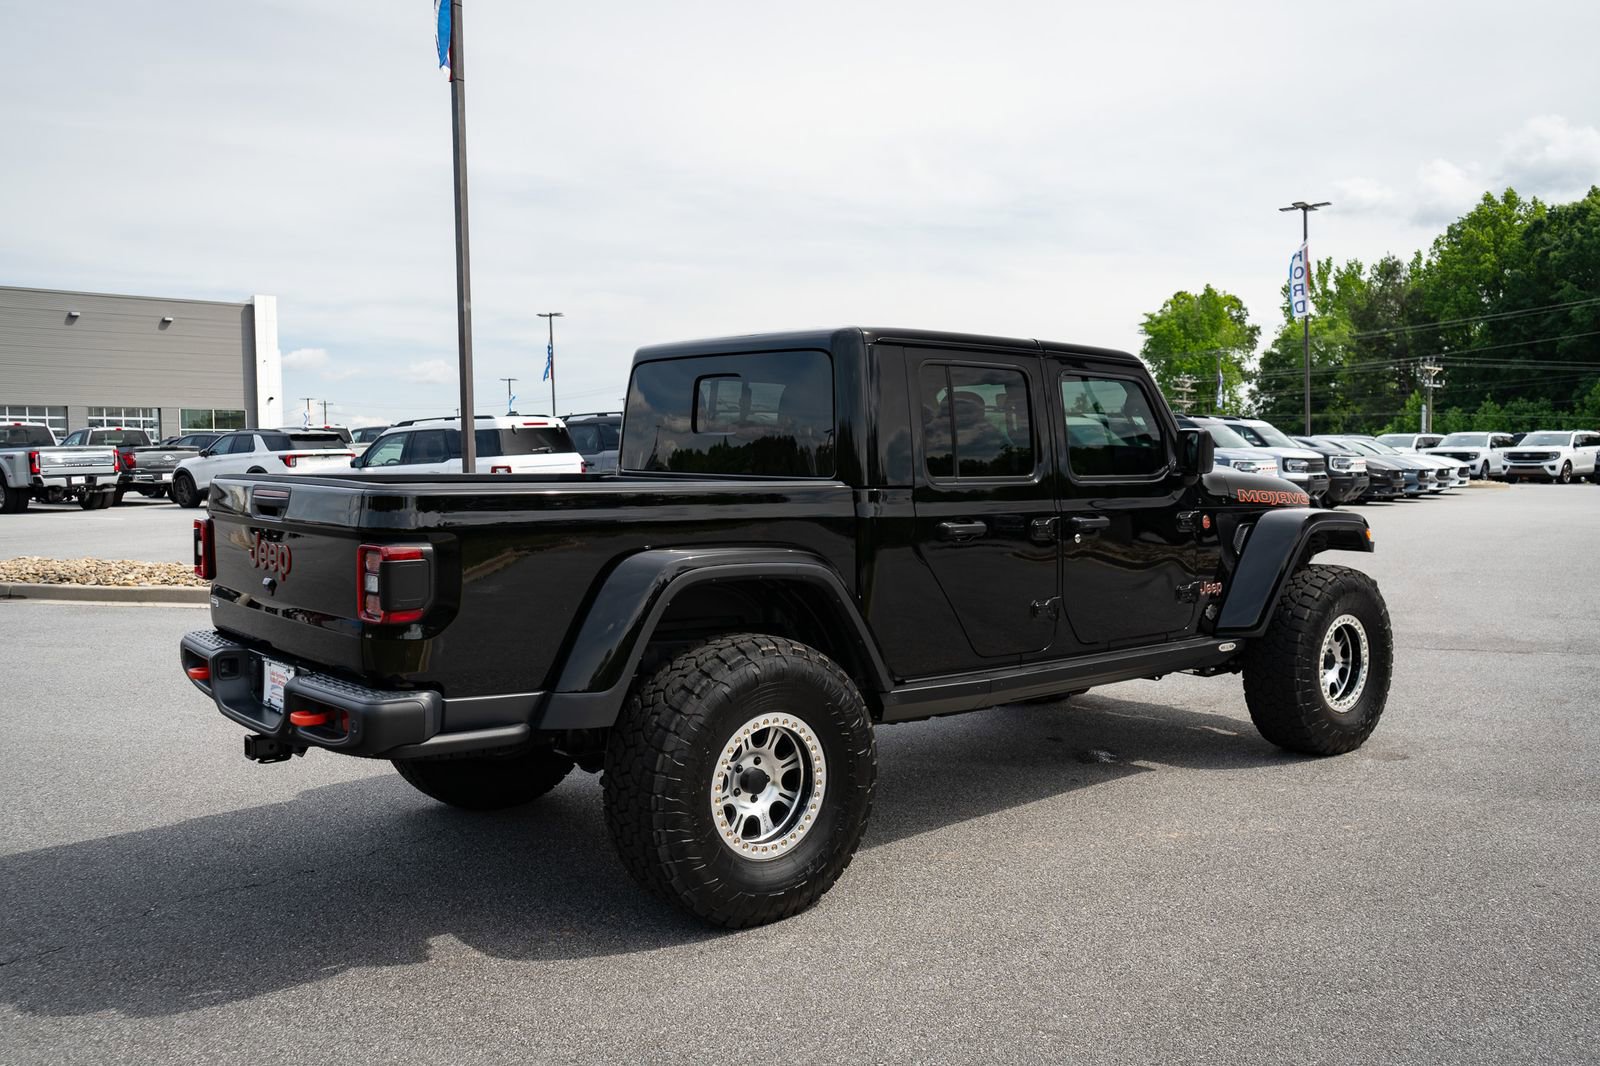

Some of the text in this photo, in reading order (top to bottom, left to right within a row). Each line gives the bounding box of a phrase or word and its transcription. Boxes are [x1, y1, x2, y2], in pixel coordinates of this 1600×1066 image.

[1237, 488, 1311, 506] MOJAVE
[249, 530, 292, 582] Jeep
[1199, 581, 1222, 596] Jeep
